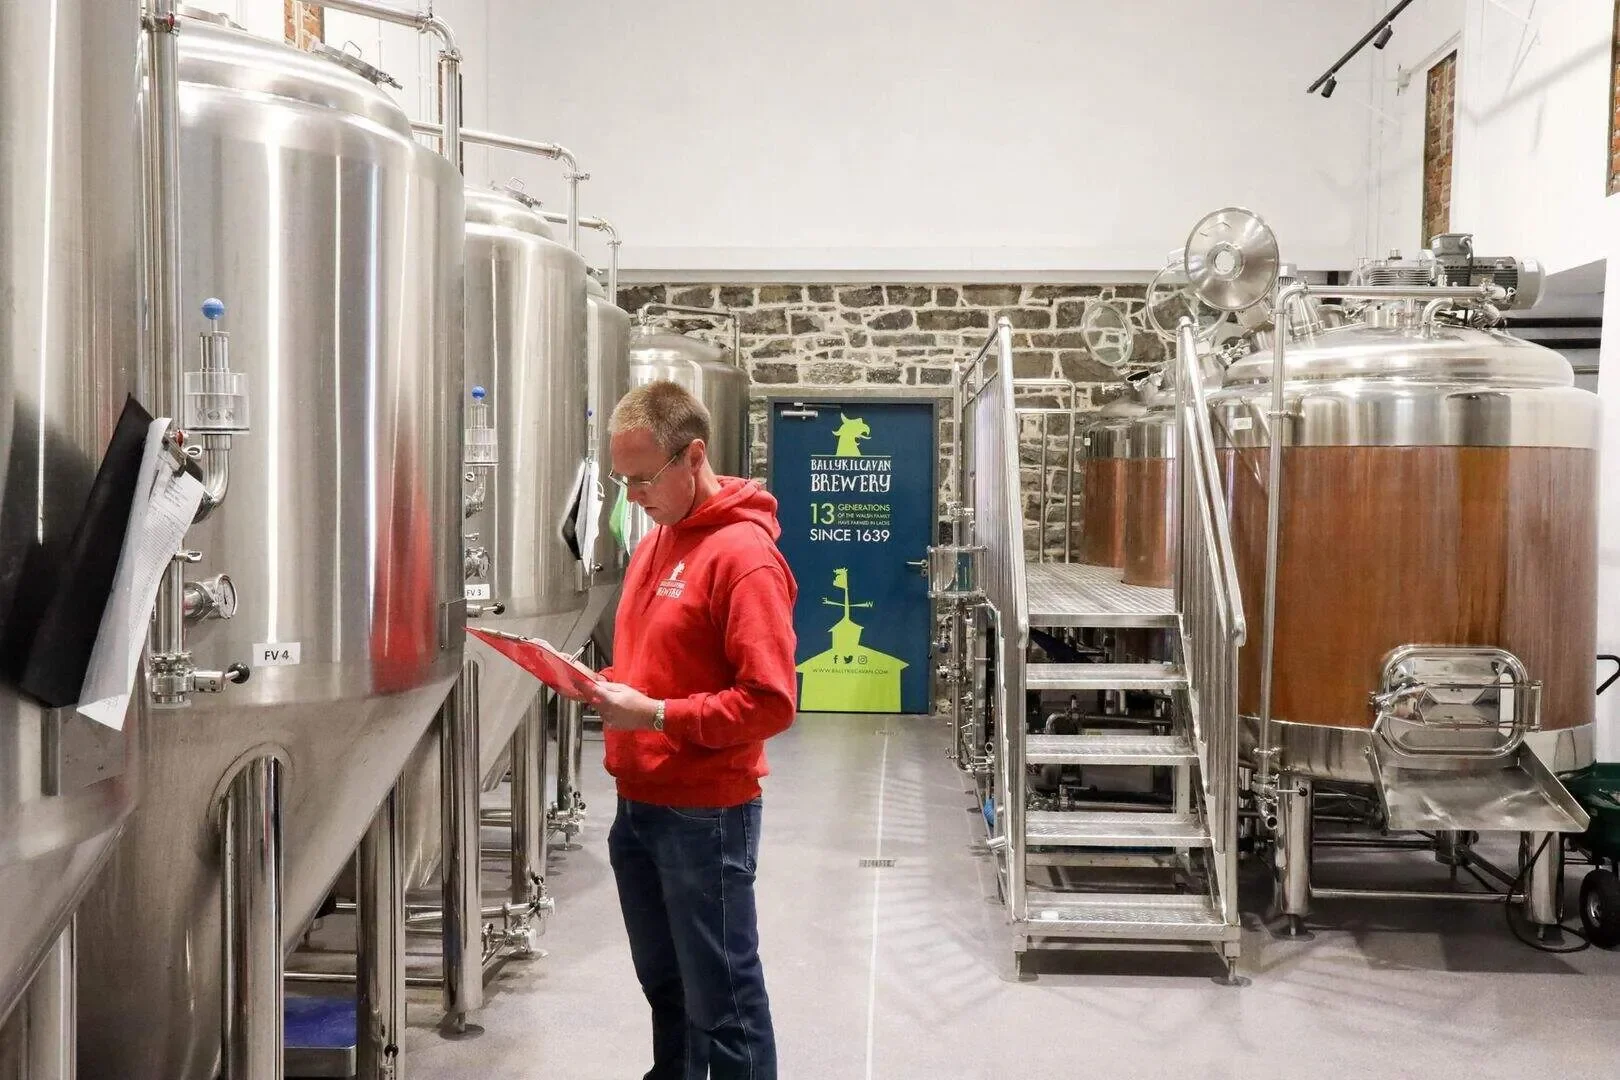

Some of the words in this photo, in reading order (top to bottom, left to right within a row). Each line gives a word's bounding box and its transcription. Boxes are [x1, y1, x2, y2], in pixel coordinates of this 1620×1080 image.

[810, 459, 892, 471] BALLYKILCAVAN
[810, 474, 892, 493] BREWERY
[837, 503, 891, 512] GENERATIONS
[810, 503, 835, 525] 13
[810, 529, 851, 542] SINCE
[856, 529, 890, 542] 1639
[466, 589, 476, 597] FV
[264, 650, 280, 661] FV
[281, 649, 290, 660] 4
